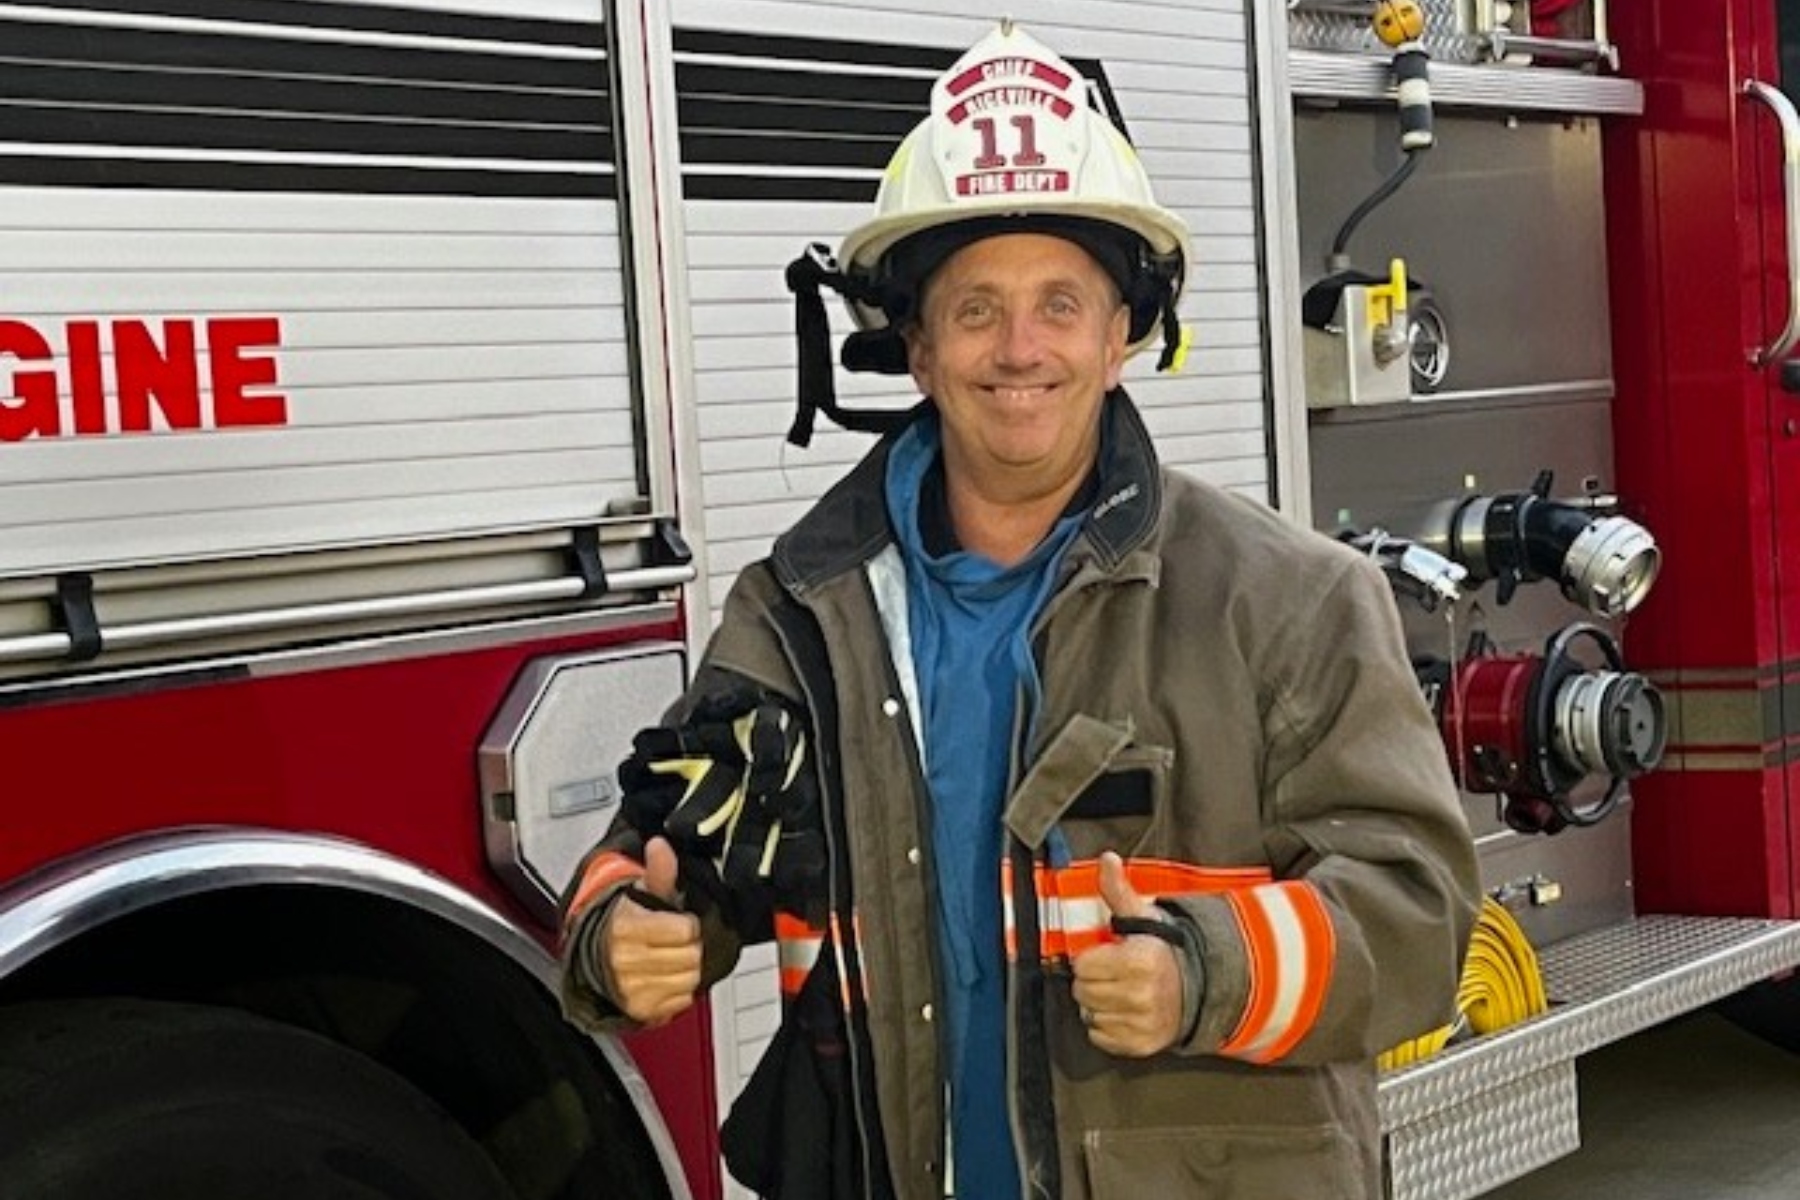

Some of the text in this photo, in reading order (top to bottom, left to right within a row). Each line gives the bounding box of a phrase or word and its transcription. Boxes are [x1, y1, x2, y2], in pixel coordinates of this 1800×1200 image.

[981, 58, 1036, 80] CHIEF
[972, 114, 1046, 169] 11
[969, 171, 1058, 195] FIRE DEPT
